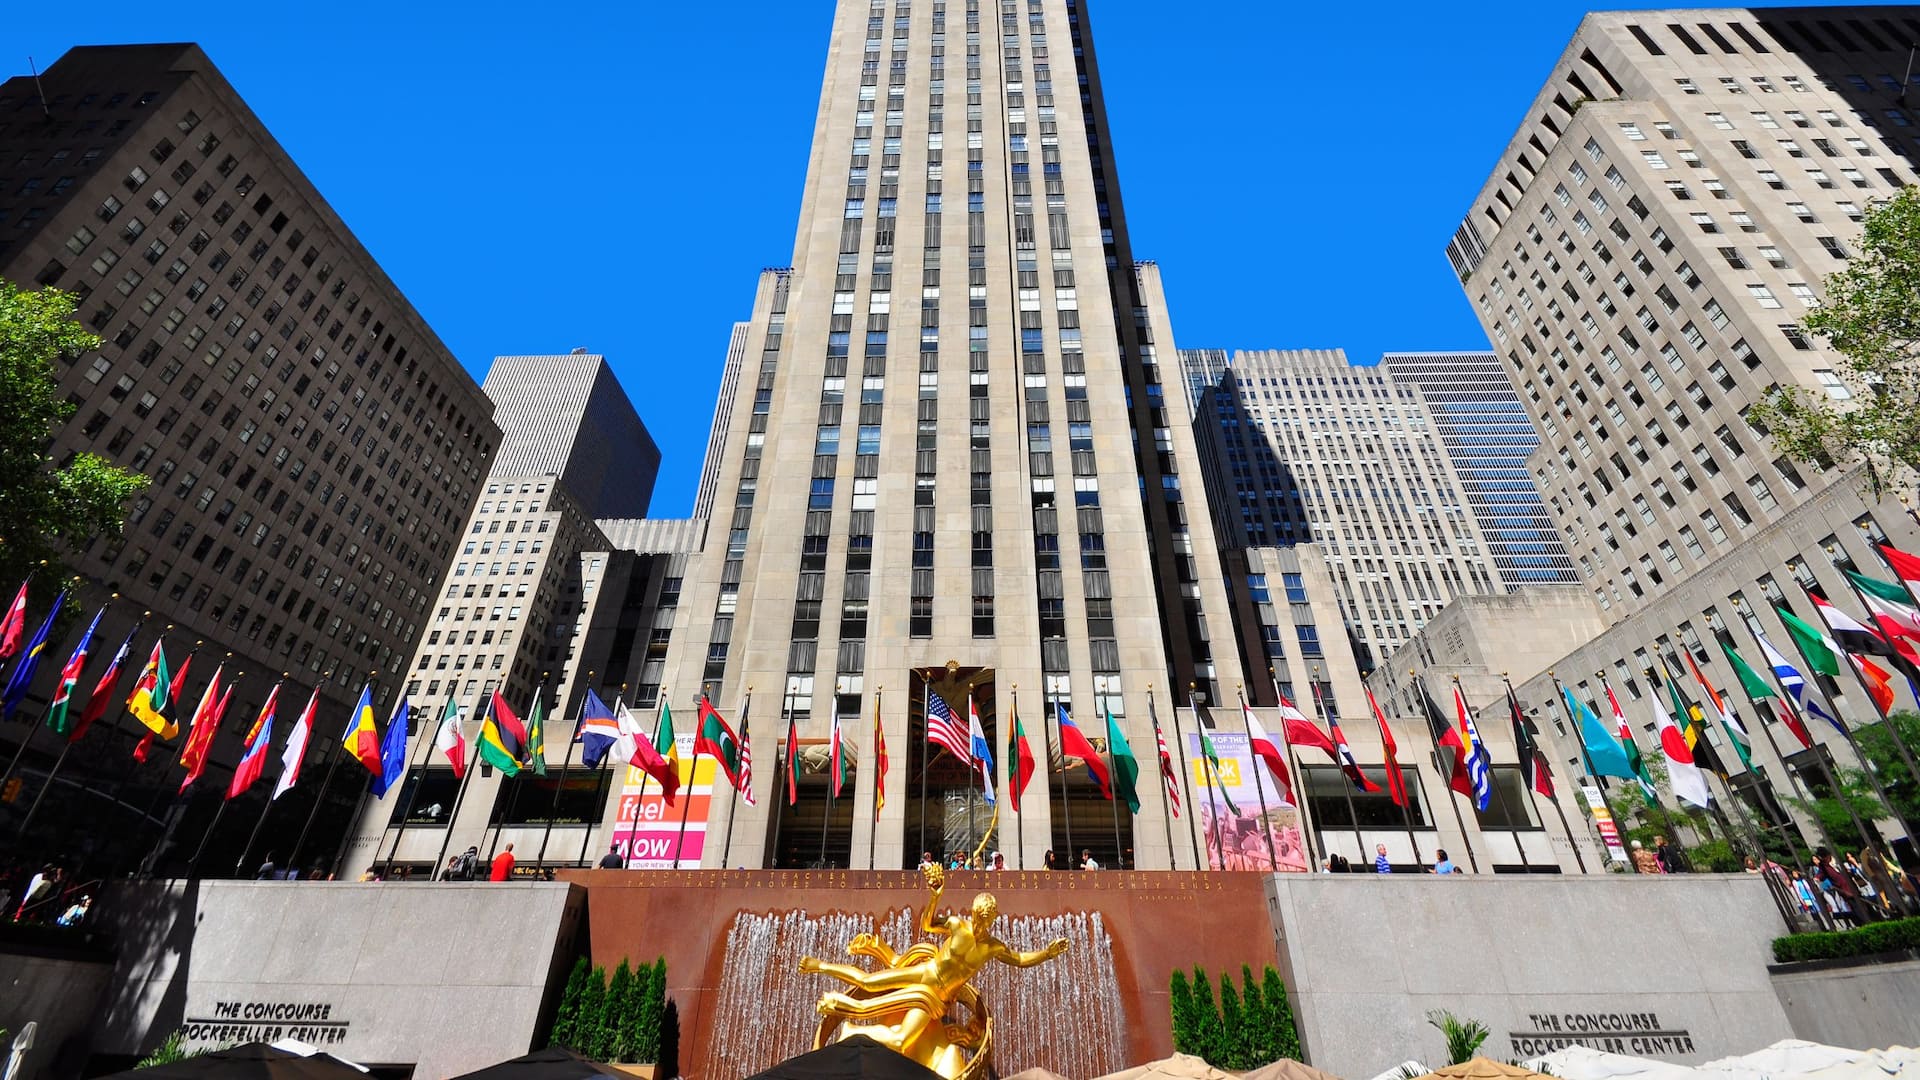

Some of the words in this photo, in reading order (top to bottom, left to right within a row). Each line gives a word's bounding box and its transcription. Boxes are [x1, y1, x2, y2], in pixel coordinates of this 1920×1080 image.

[622, 797, 665, 820] feel
[769, 872, 846, 880] TEACHER
[1021, 873, 1099, 881] BROUGHT
[1118, 873, 1148, 881] THE
[984, 881, 1039, 889] MEANS
[214, 1002, 241, 1018] THE
[244, 1003, 331, 1020] CONCOURSE
[1529, 1014, 1561, 1031] THE
[1565, 1013, 1661, 1031] CONCOURSE
[288, 1027, 347, 1044] CENTER
[1631, 1037, 1696, 1054] CENTER
